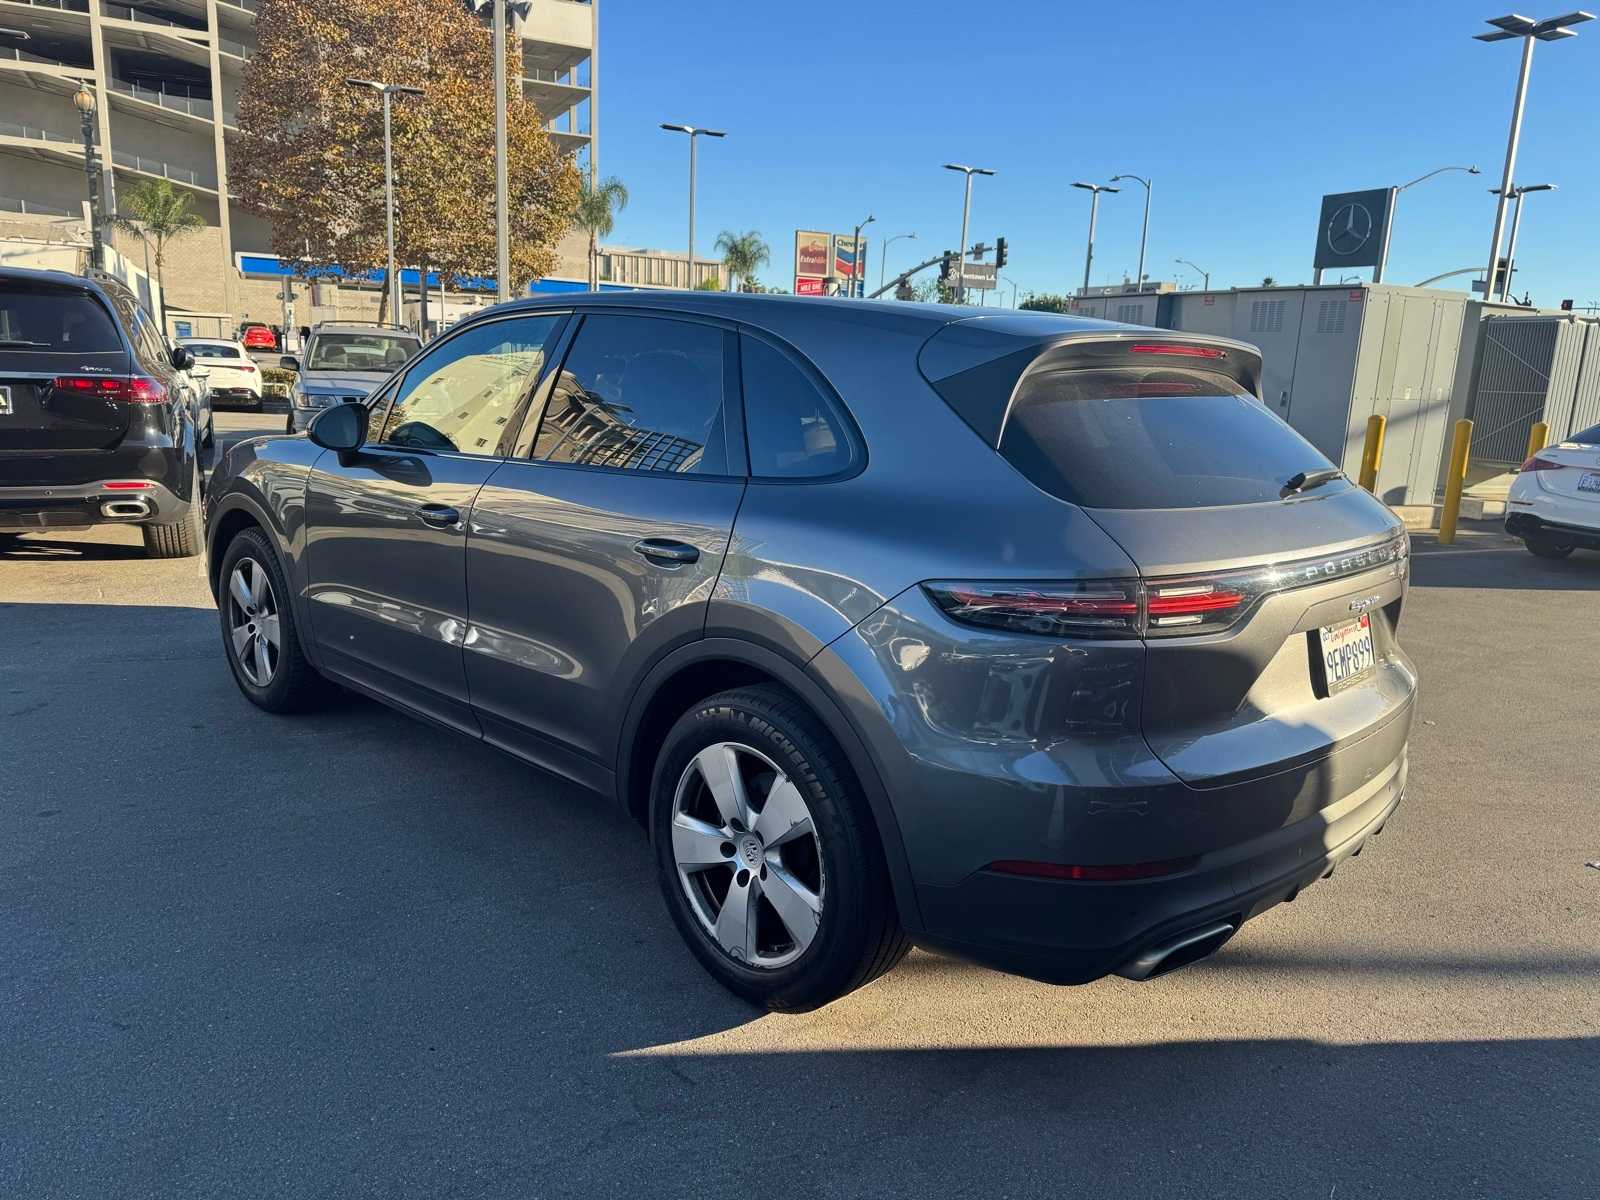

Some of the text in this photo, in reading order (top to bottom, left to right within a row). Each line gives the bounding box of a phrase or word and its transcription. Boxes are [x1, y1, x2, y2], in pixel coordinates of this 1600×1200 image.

[836, 239, 865, 250] Chevn
[957, 272, 986, 281] Dwntown
[1326, 635, 1371, 682] 9EMP899
[747, 716, 828, 800] MICHELIN
